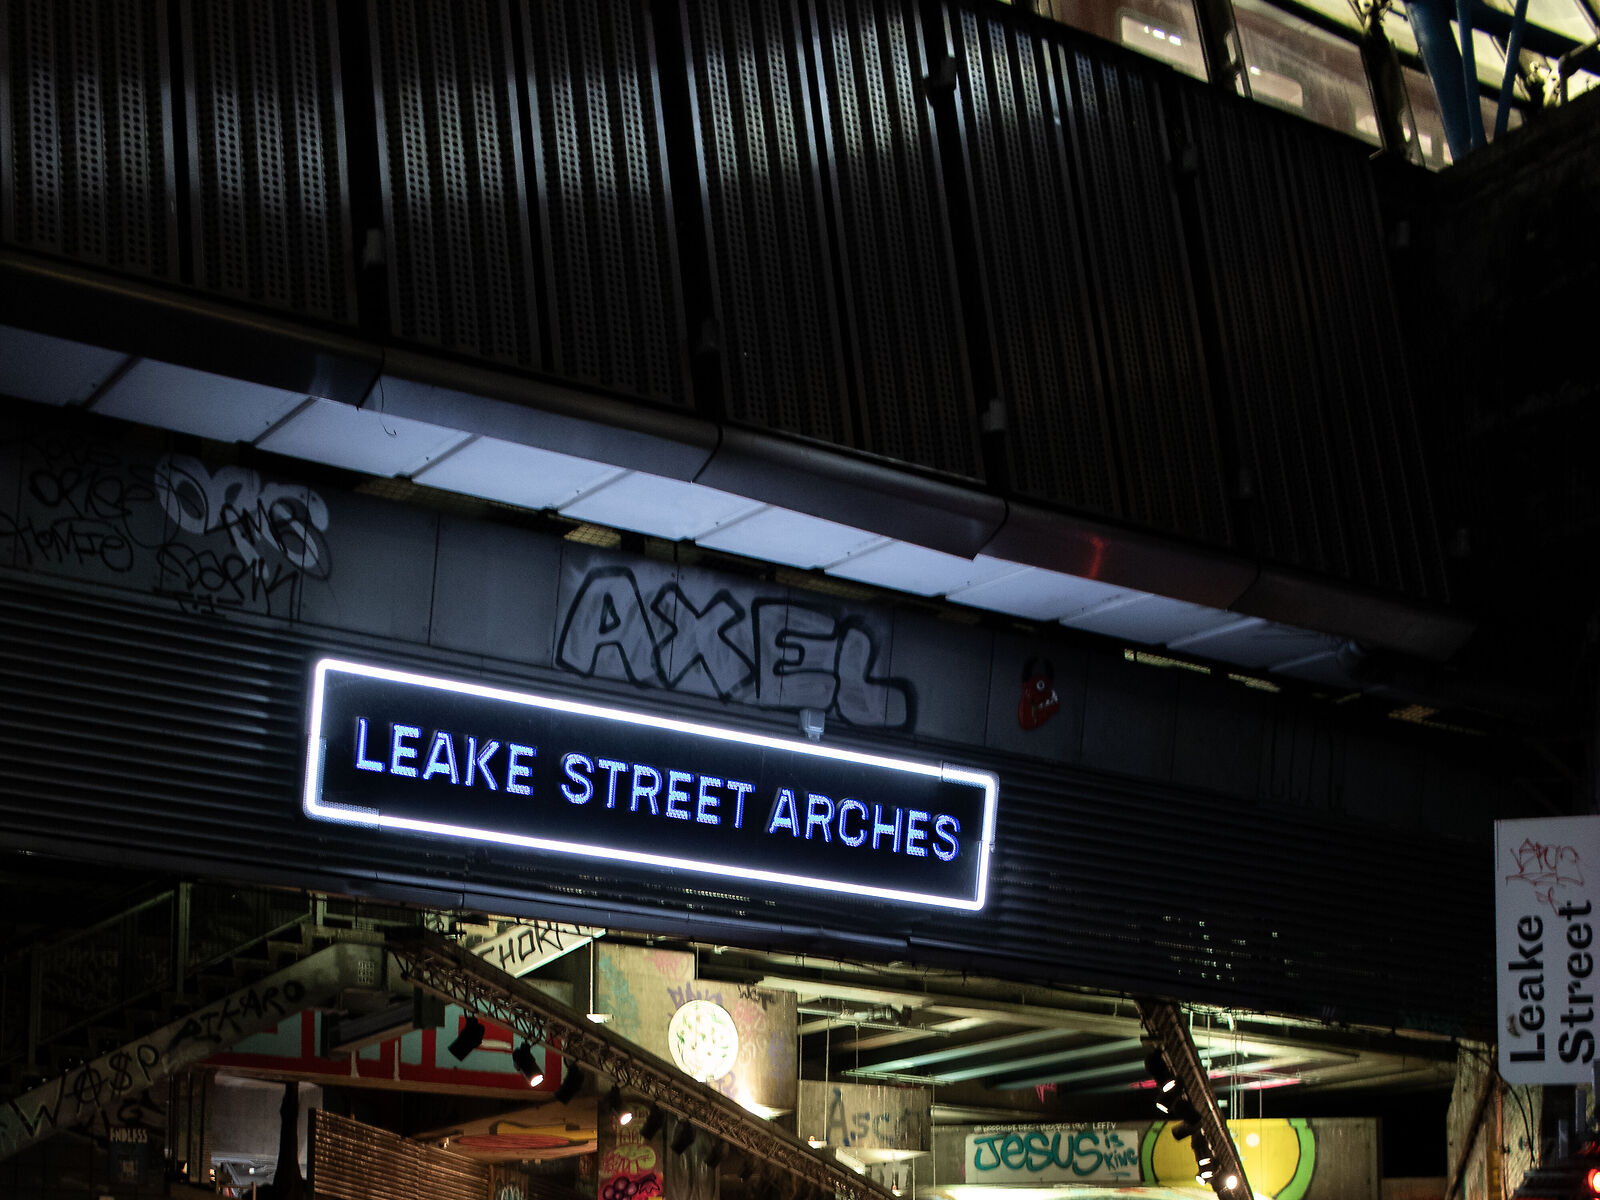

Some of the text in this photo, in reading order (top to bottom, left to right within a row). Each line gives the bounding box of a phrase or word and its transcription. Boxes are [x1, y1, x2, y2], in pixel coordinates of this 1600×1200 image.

[555, 566, 915, 732] AXEL
[354, 716, 963, 863] LEAKE STREET ARCHES
[1508, 915, 1546, 1062] Leake
[1558, 899, 1595, 1064] Street
